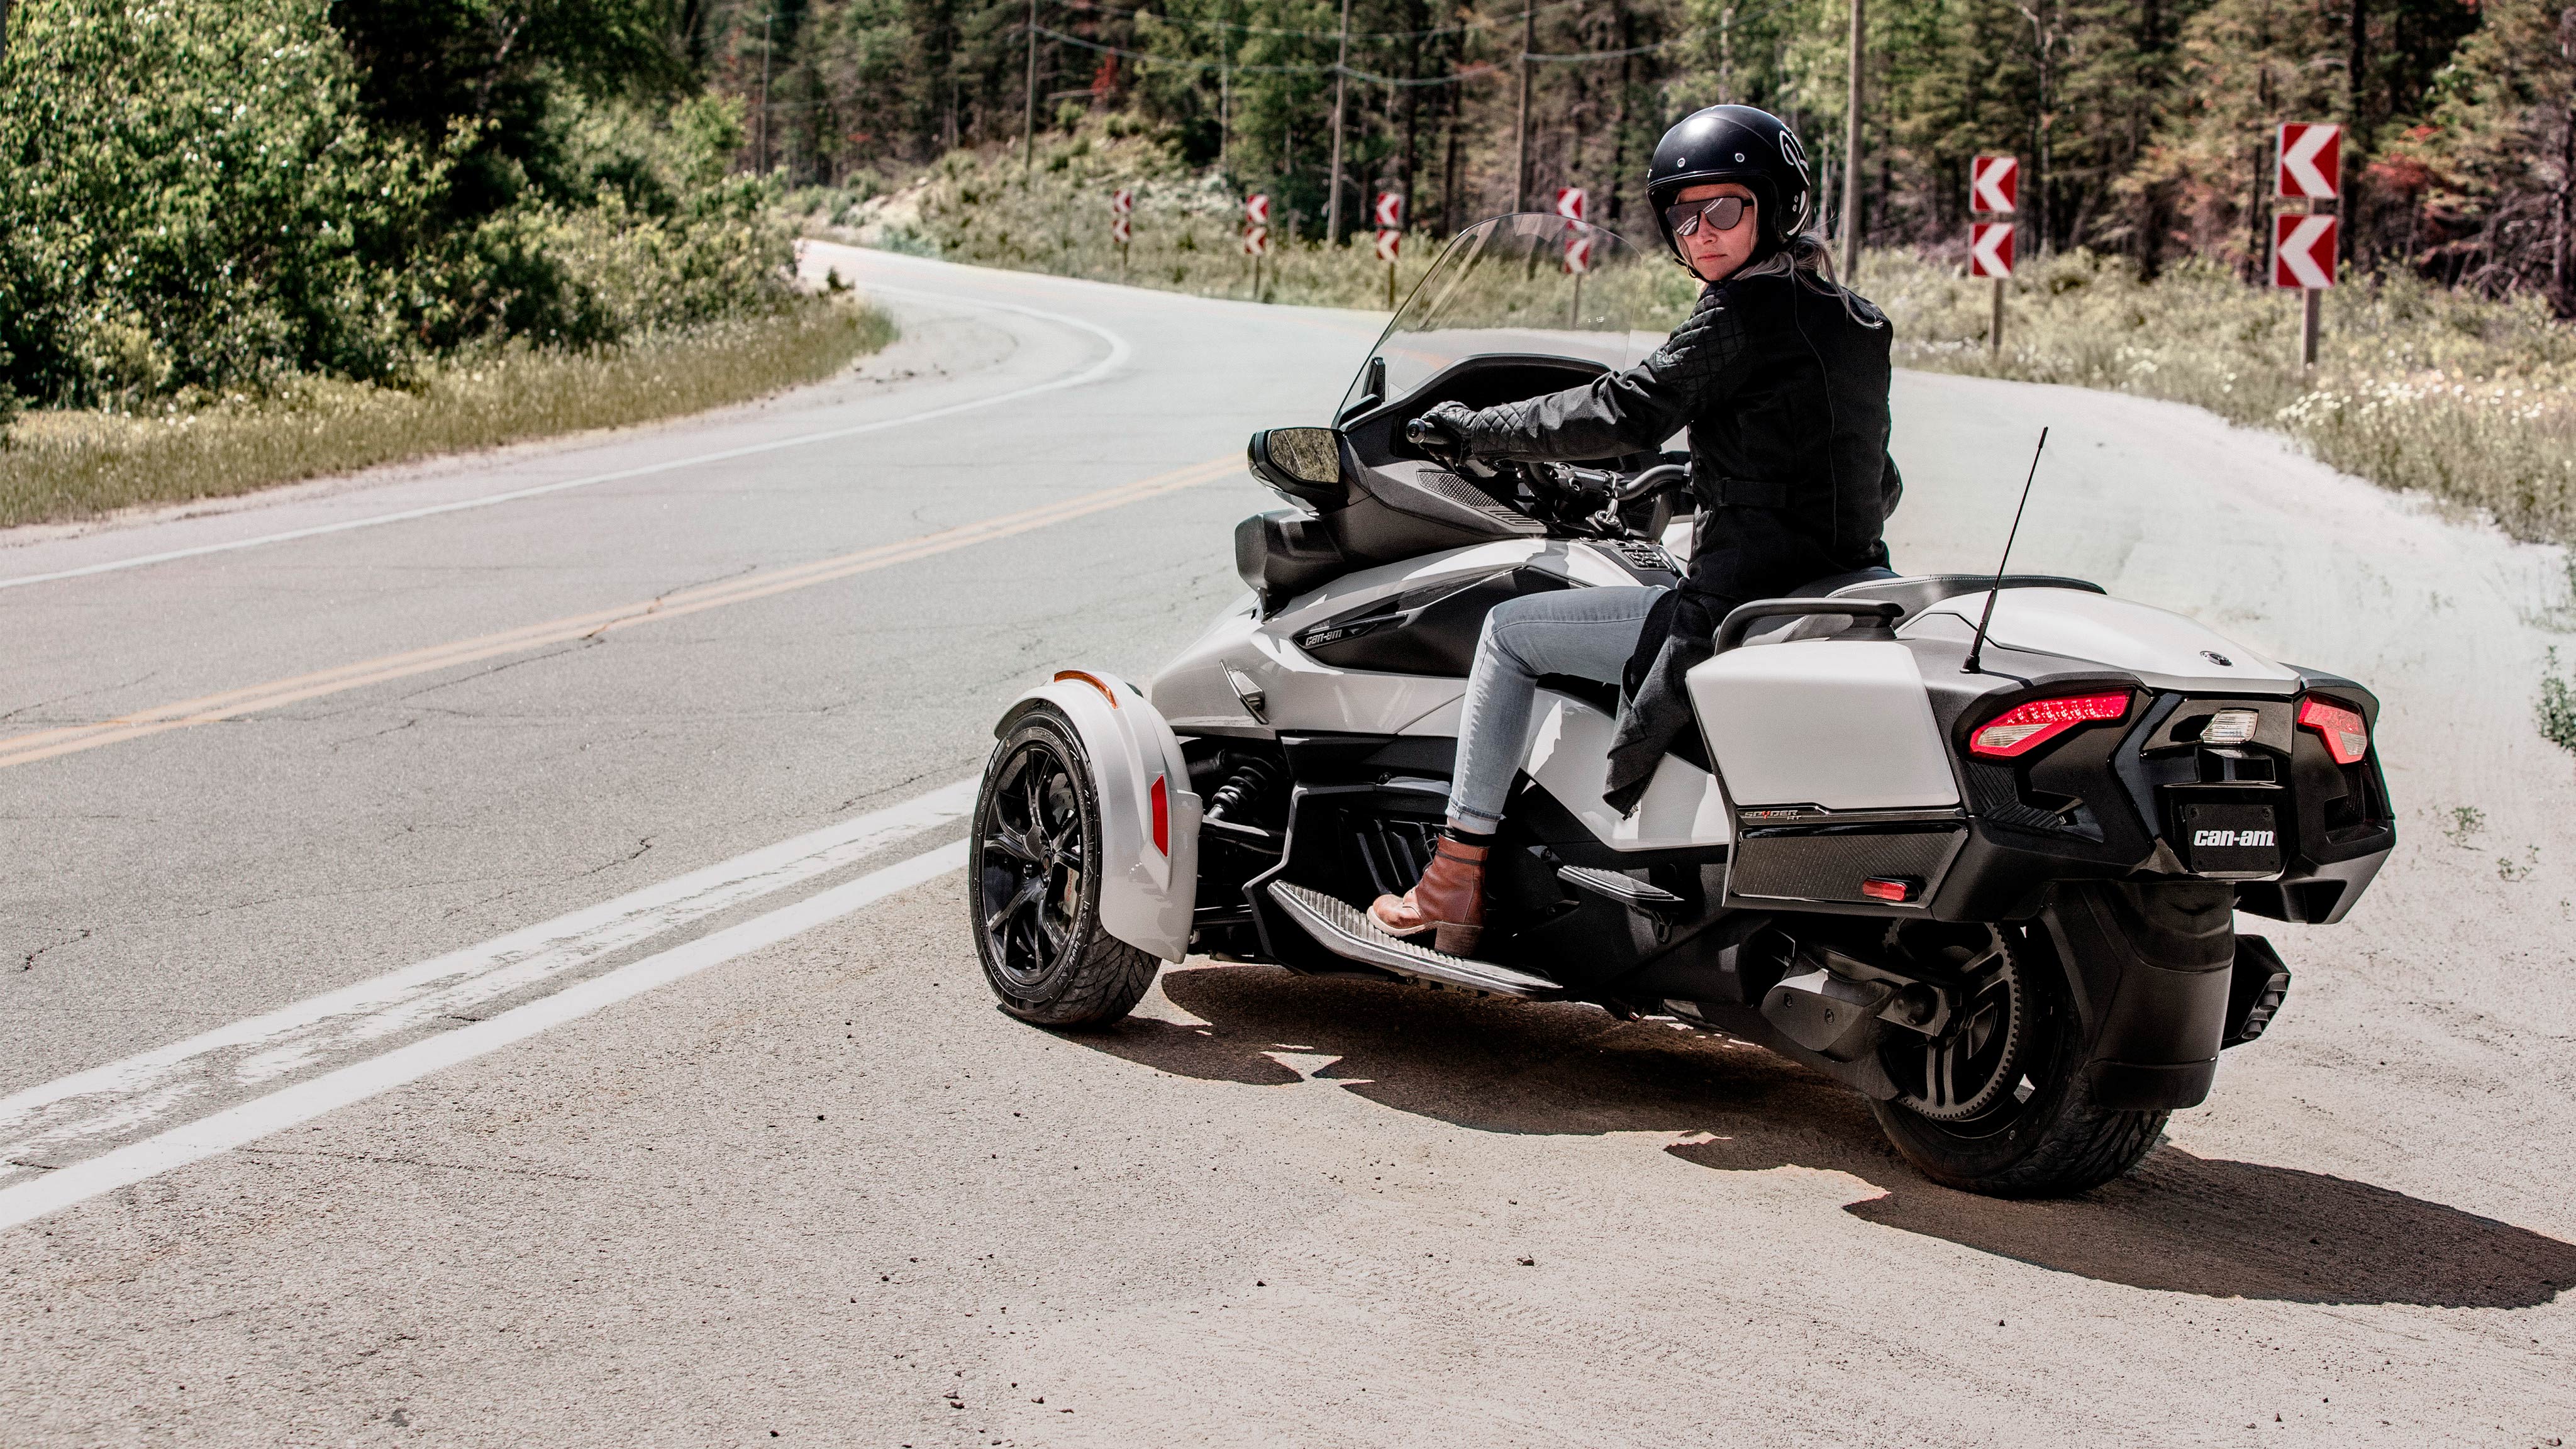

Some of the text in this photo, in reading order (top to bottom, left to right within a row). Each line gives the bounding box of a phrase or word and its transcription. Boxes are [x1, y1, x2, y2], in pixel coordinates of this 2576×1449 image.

[1305, 629, 1343, 646] can-am
[1745, 809, 1798, 819] SPYDER
[2194, 830, 2274, 847] can-am
